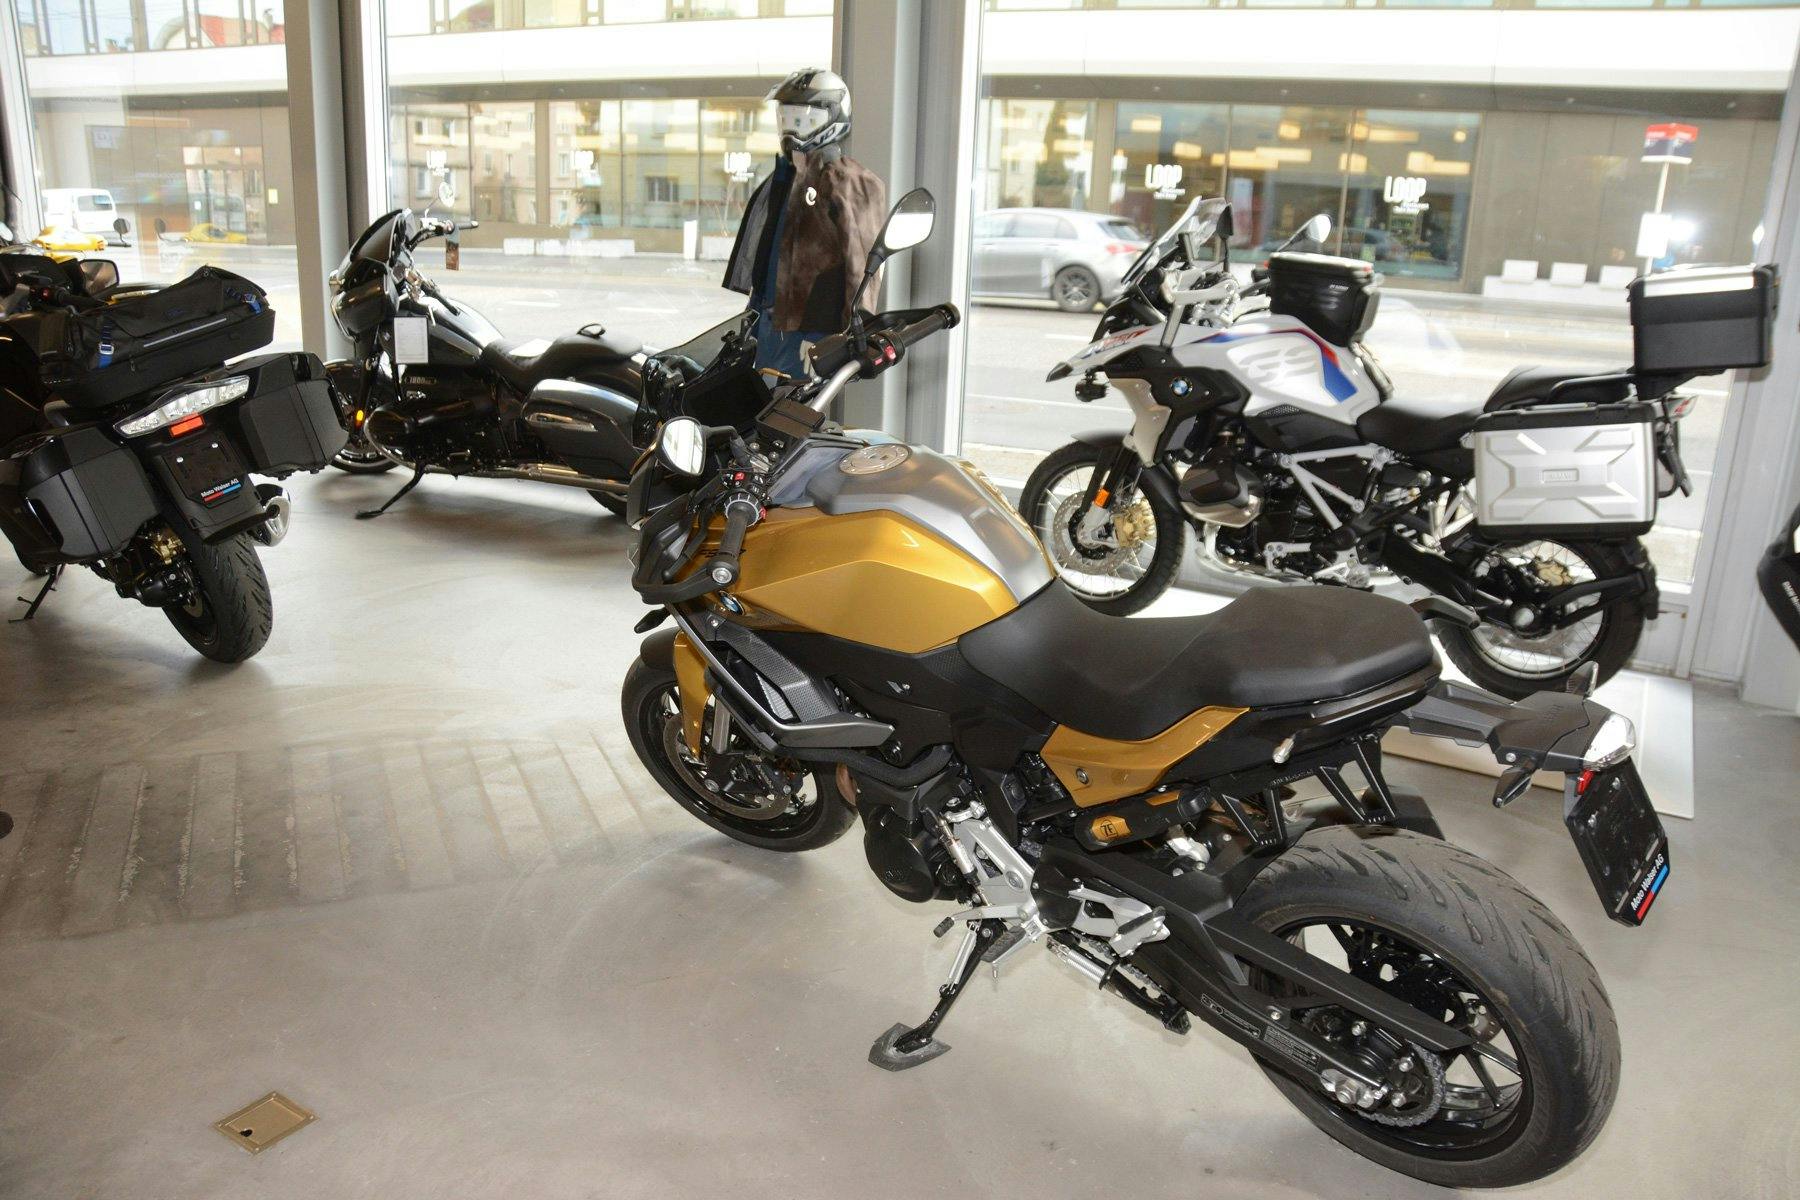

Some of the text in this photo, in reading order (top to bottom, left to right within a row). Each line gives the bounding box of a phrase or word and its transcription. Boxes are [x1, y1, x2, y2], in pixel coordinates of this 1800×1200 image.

[1383, 175, 1427, 203] LOOP
[200, 490, 215, 498] Moto
[1630, 889, 1646, 911] Moto
[1654, 853, 1665, 870] AG
